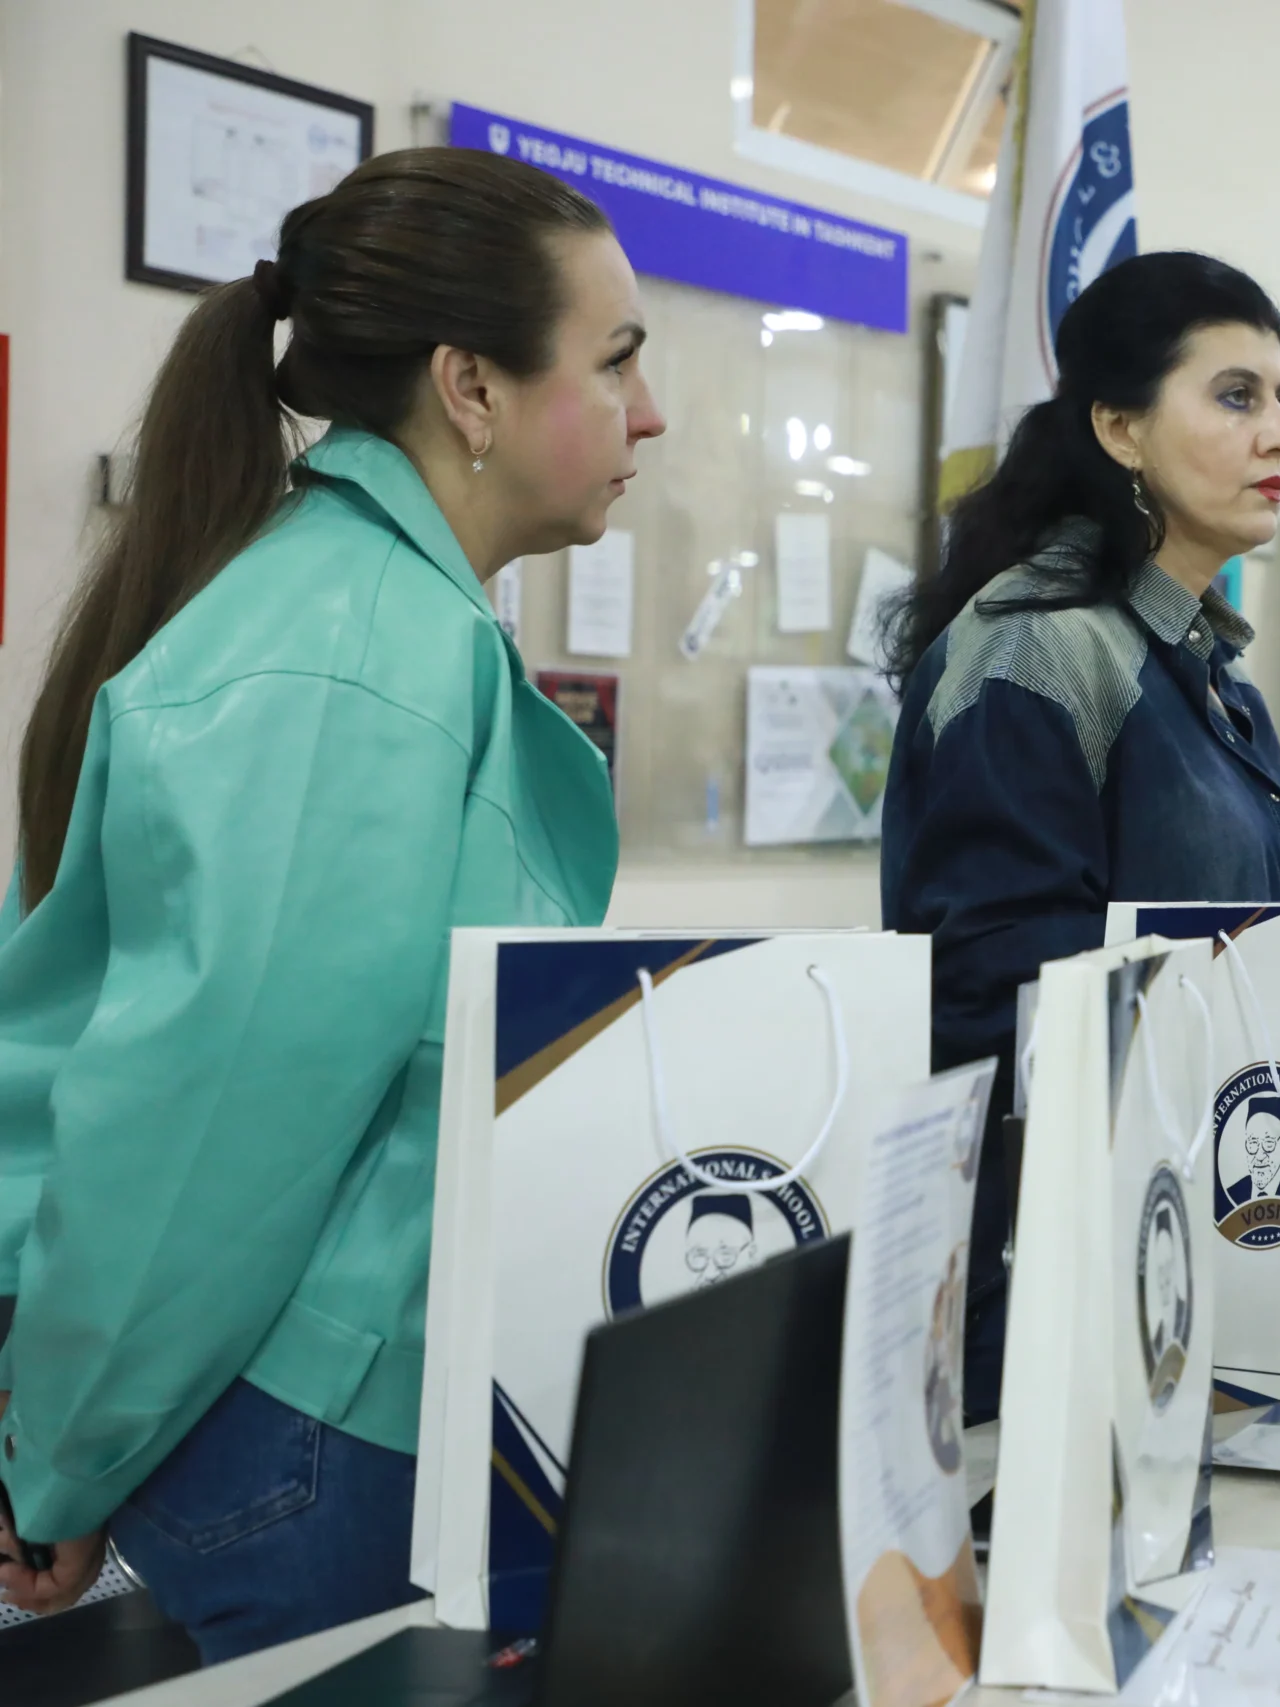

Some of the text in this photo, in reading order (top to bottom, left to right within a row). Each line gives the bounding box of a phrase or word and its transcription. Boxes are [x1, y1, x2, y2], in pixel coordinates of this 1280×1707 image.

[516, 133, 897, 260] YEOJU TECHNICAL INSTITUTE IN TASHKENT
[621, 1159, 817, 1253] INTERNAONAL SHOOL
